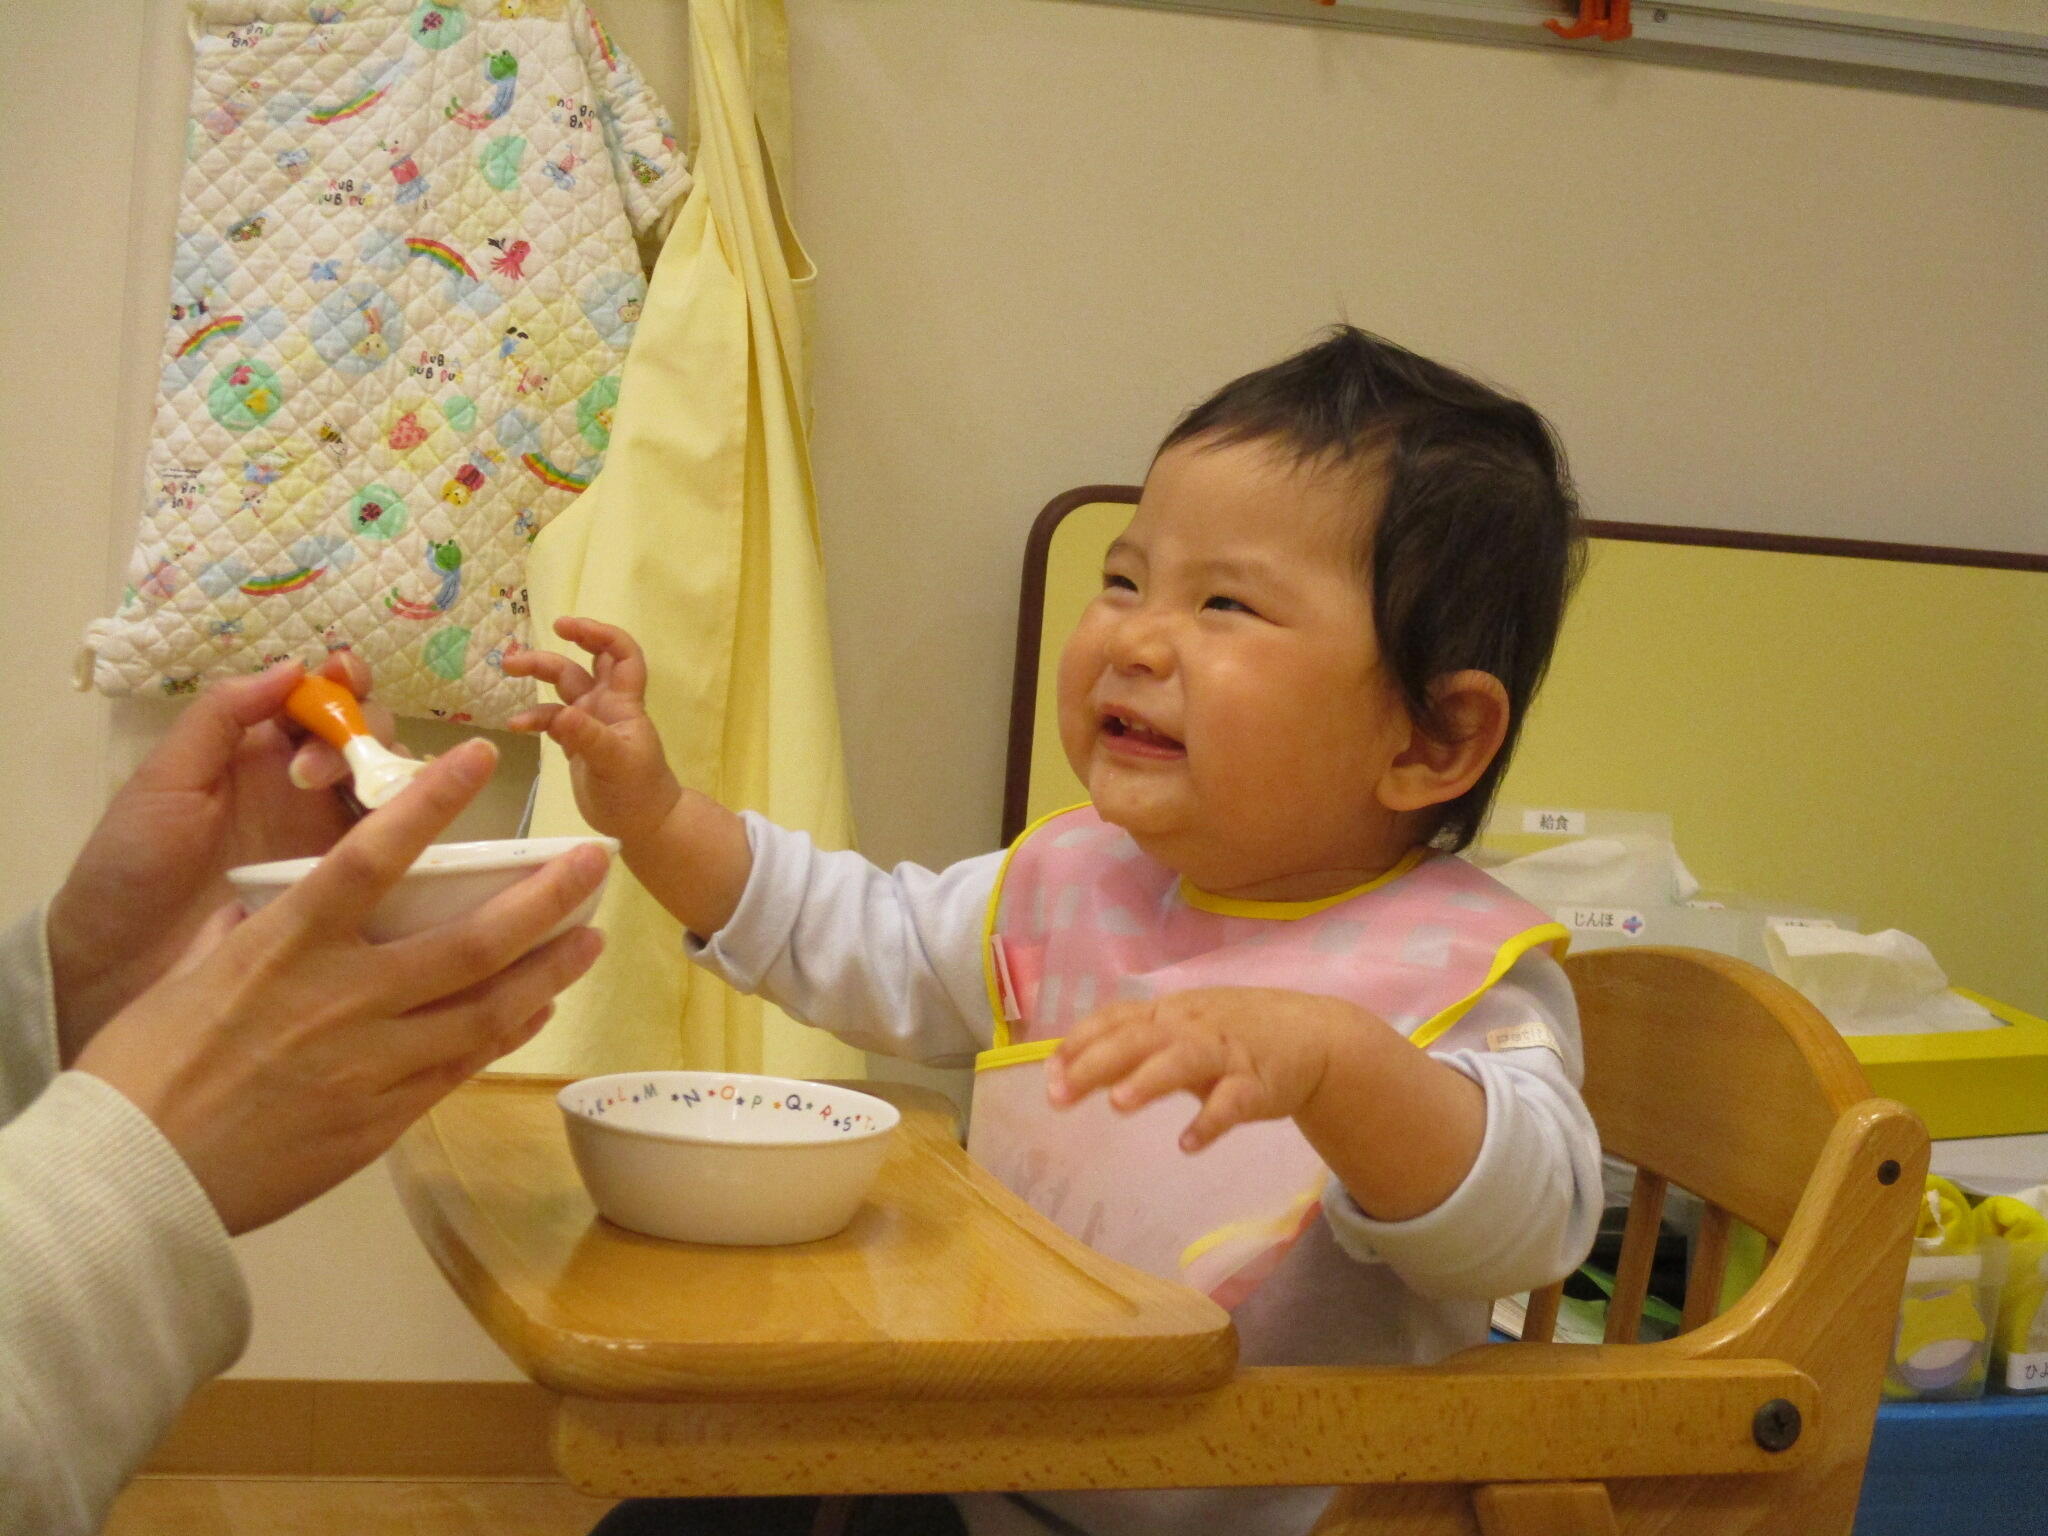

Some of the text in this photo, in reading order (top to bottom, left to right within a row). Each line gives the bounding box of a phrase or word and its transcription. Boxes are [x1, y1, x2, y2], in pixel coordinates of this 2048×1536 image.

[1540, 814, 1569, 832] 給食
[644, 1083, 658, 1099] M
[683, 1089, 701, 1108] N
[720, 1085, 735, 1100] O
[752, 1095, 762, 1109] P
[786, 1094, 802, 1111] Q
[843, 1116, 851, 1132] S
